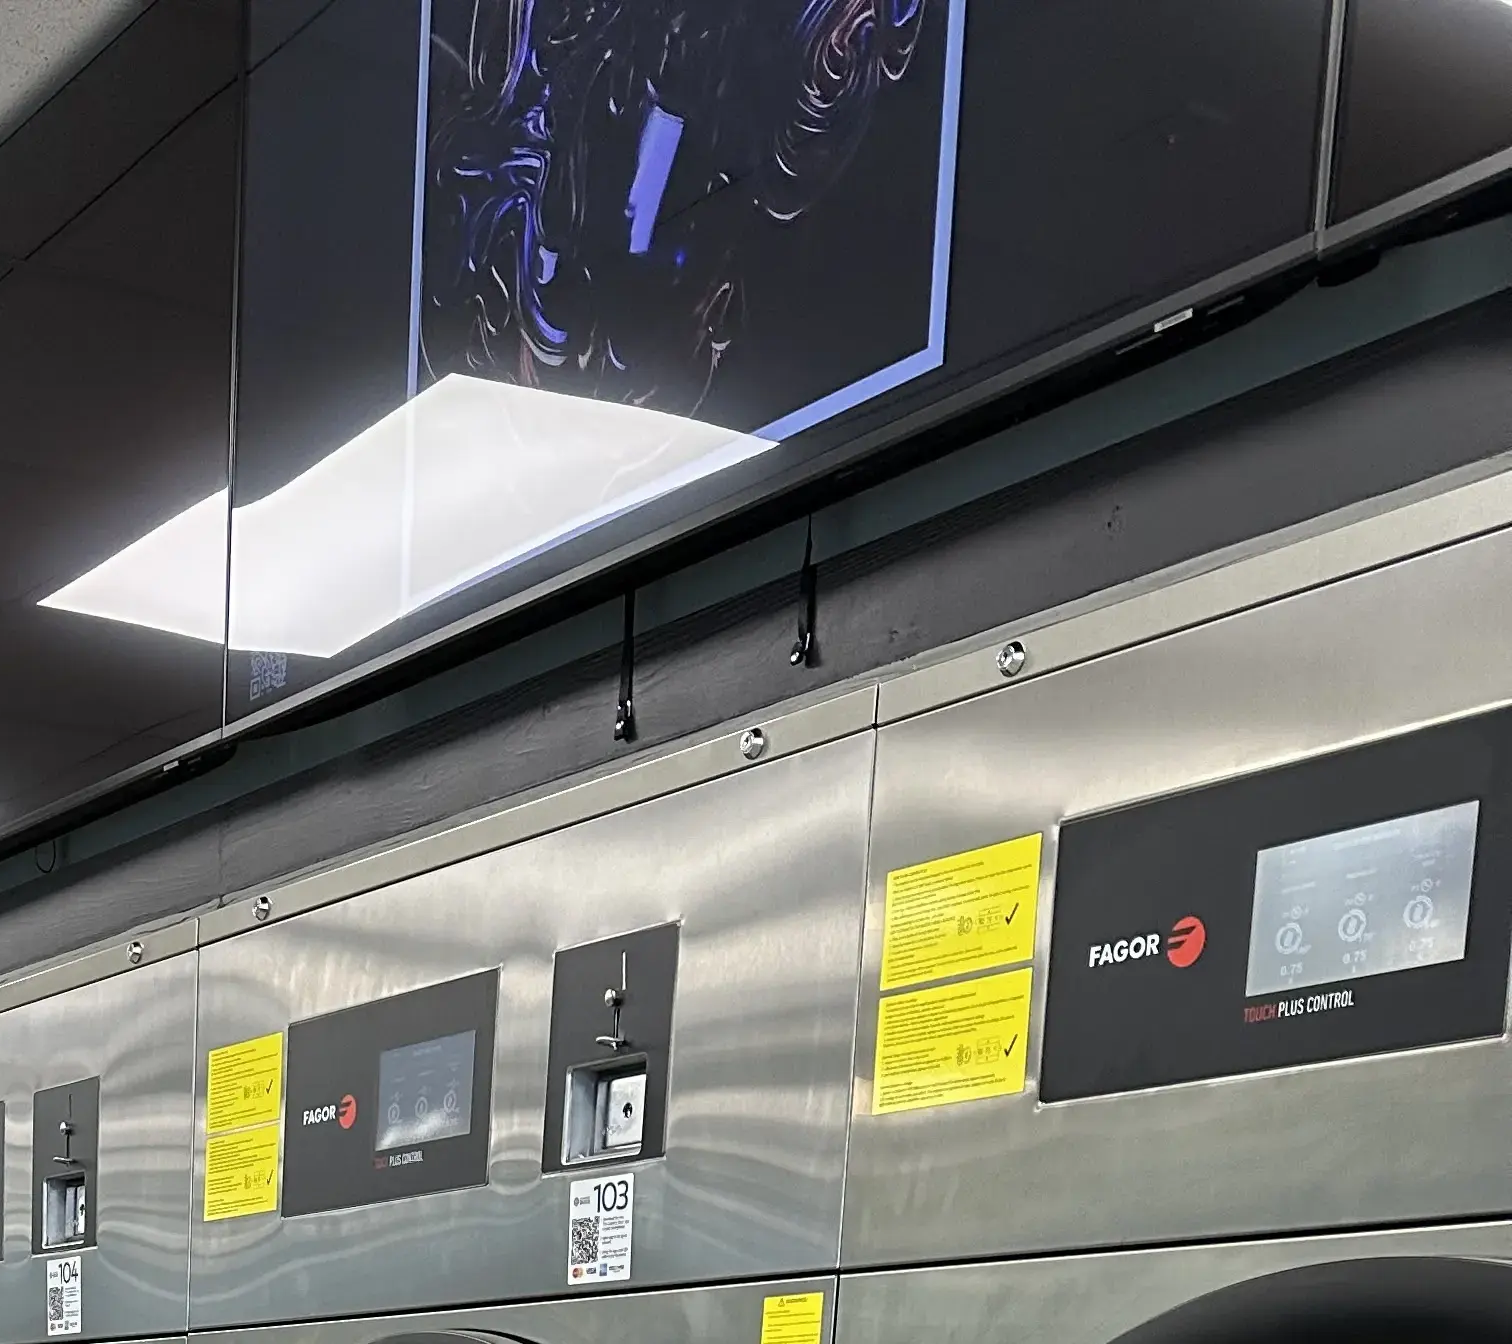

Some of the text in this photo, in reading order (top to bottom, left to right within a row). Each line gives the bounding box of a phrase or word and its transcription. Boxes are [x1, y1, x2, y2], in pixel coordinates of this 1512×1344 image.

[1088, 933, 1161, 968] FAGOR
[1243, 990, 1354, 1023] TOUCH PLUS CONTROL
[303, 1104, 336, 1126] FAGOR
[593, 1180, 628, 1213] 103
[58, 1260, 78, 1284] 104
